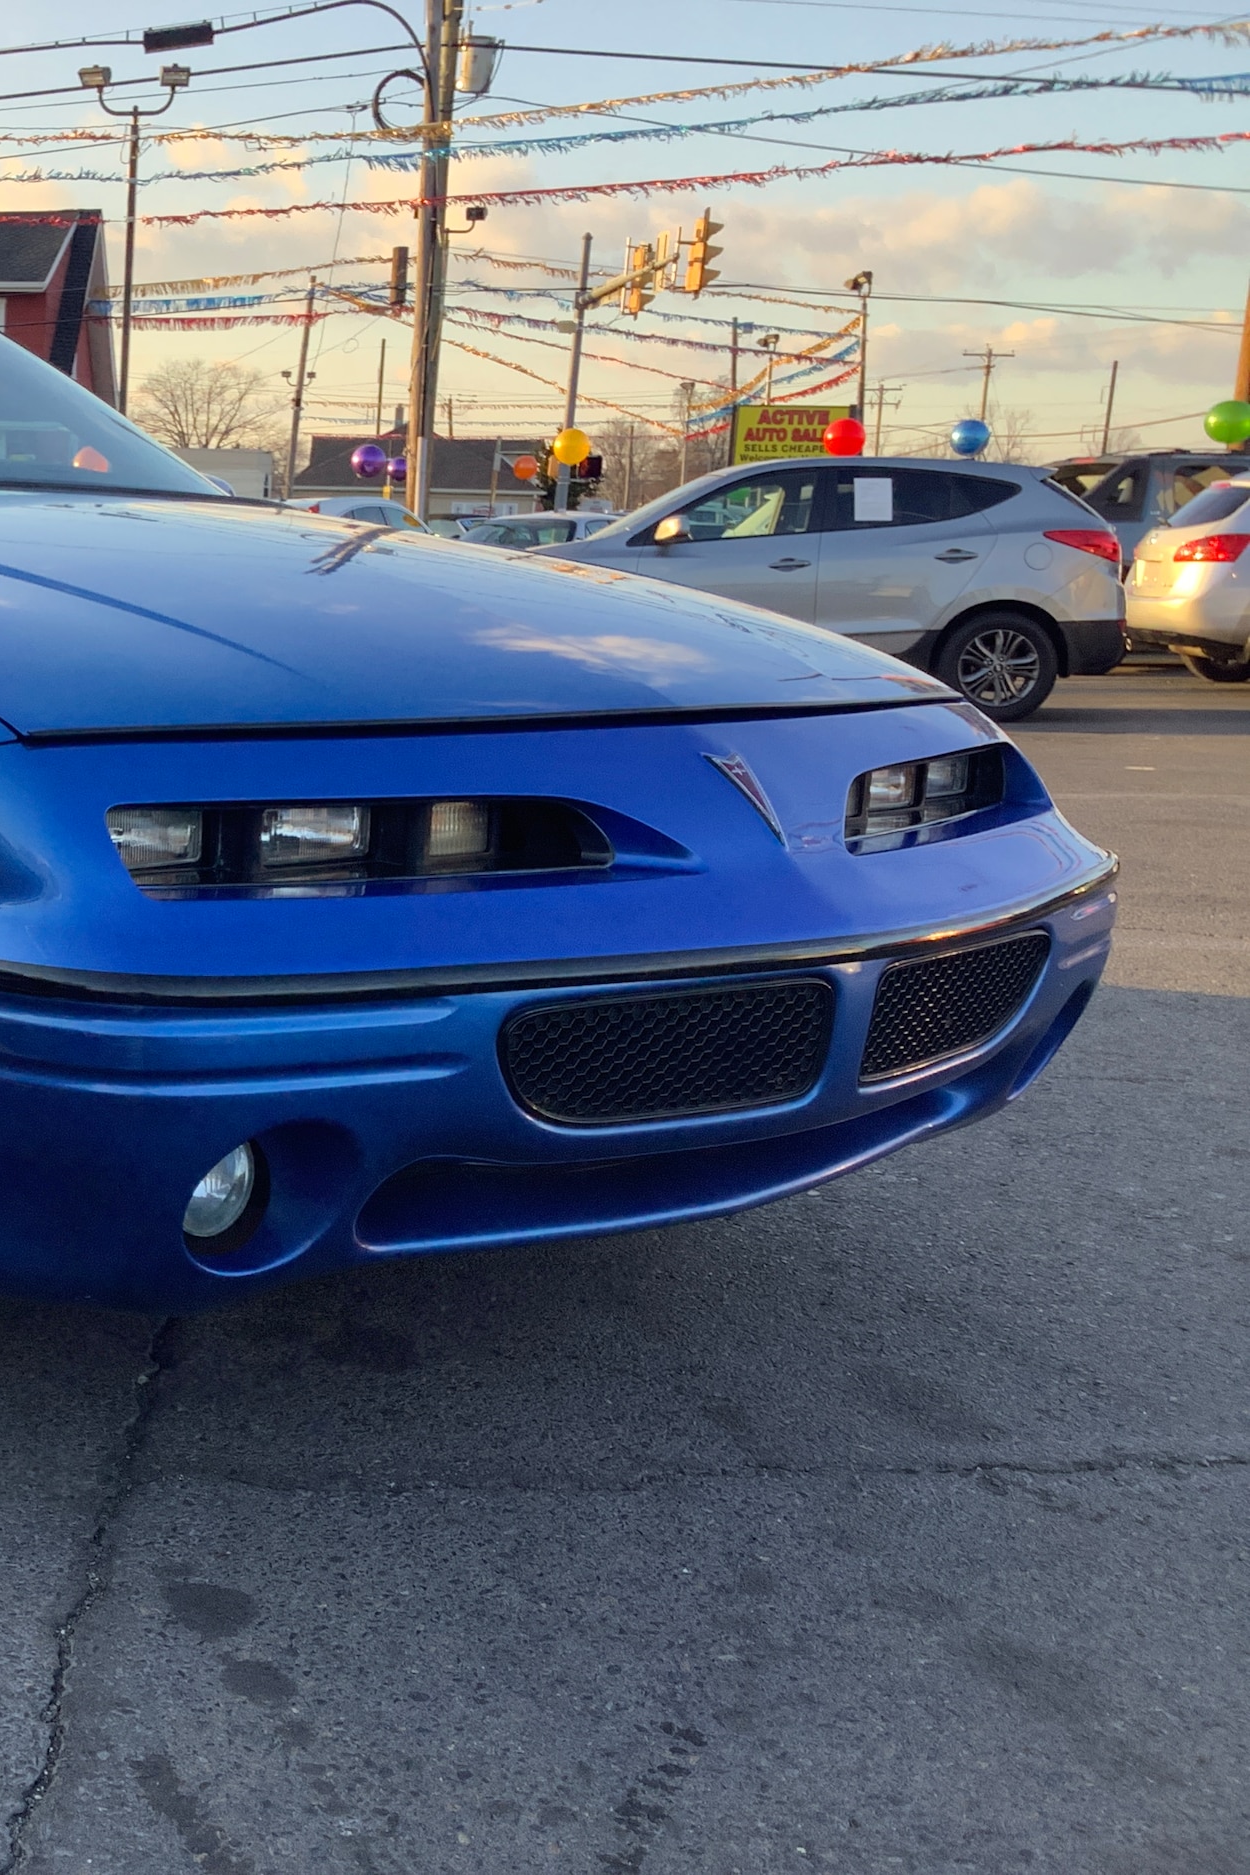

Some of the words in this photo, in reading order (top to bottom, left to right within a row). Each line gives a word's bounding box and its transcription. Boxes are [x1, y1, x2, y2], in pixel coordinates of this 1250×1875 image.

[757, 409, 831, 425] ACTIVE
[743, 428, 788, 442] AUTO
[744, 444, 778, 453] SELLS
[781, 444, 827, 453] CHEAPE
